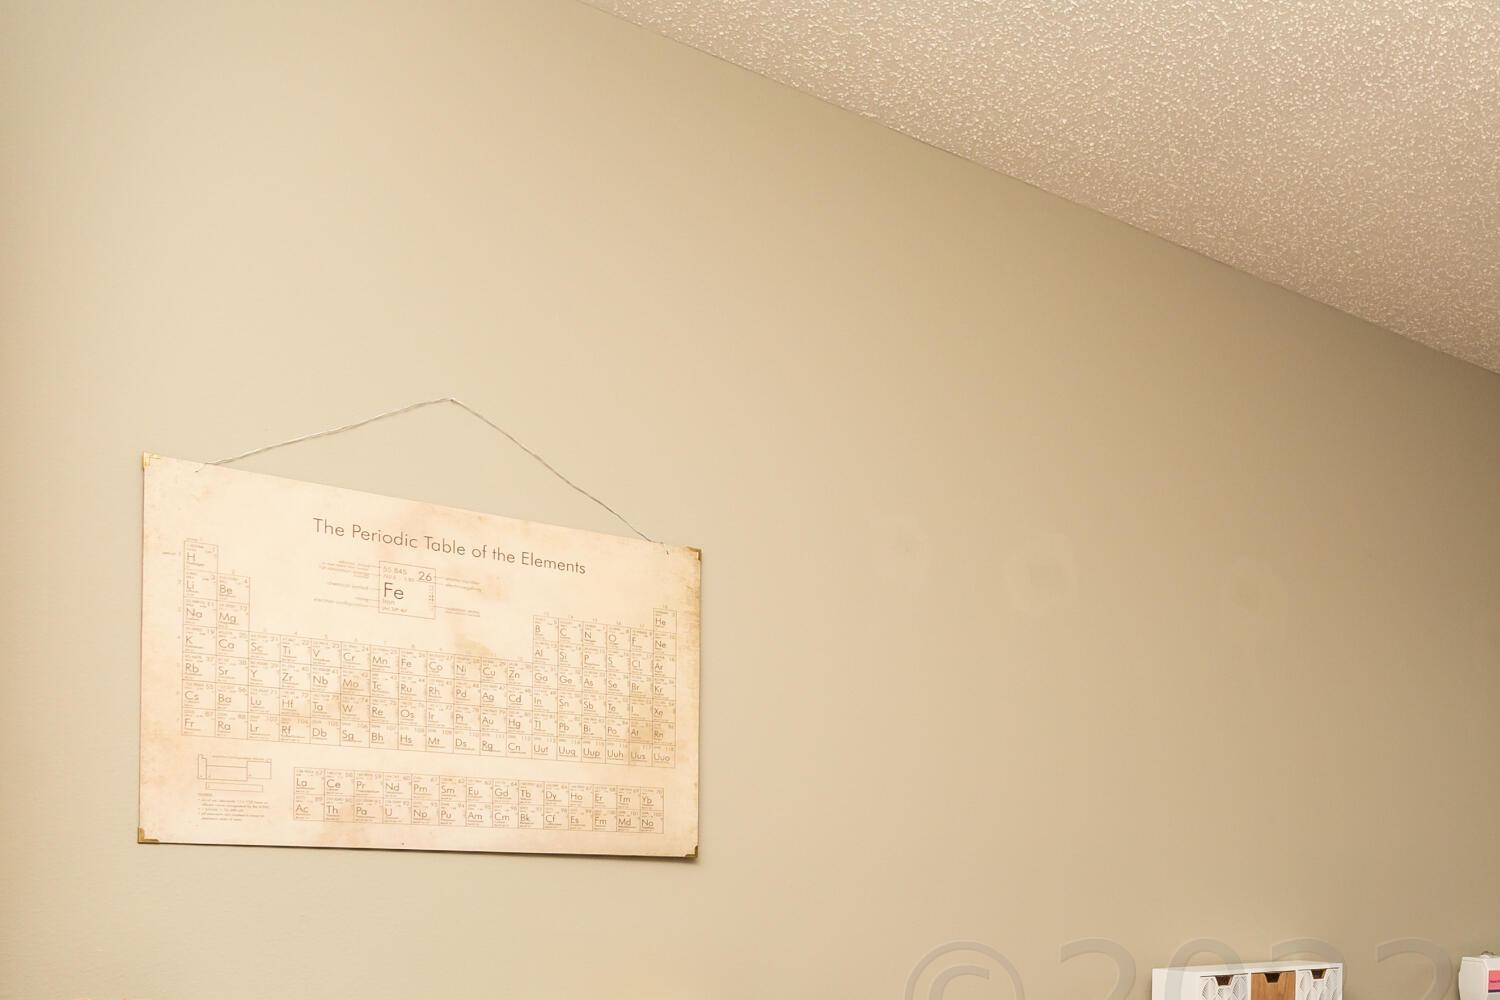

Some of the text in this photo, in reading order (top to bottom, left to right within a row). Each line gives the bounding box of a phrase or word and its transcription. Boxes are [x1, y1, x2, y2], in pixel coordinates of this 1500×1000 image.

[313, 518, 586, 575] The Periodic Table of the Elements
[418, 571, 432, 581] 26
[384, 582, 404, 600] Fe
